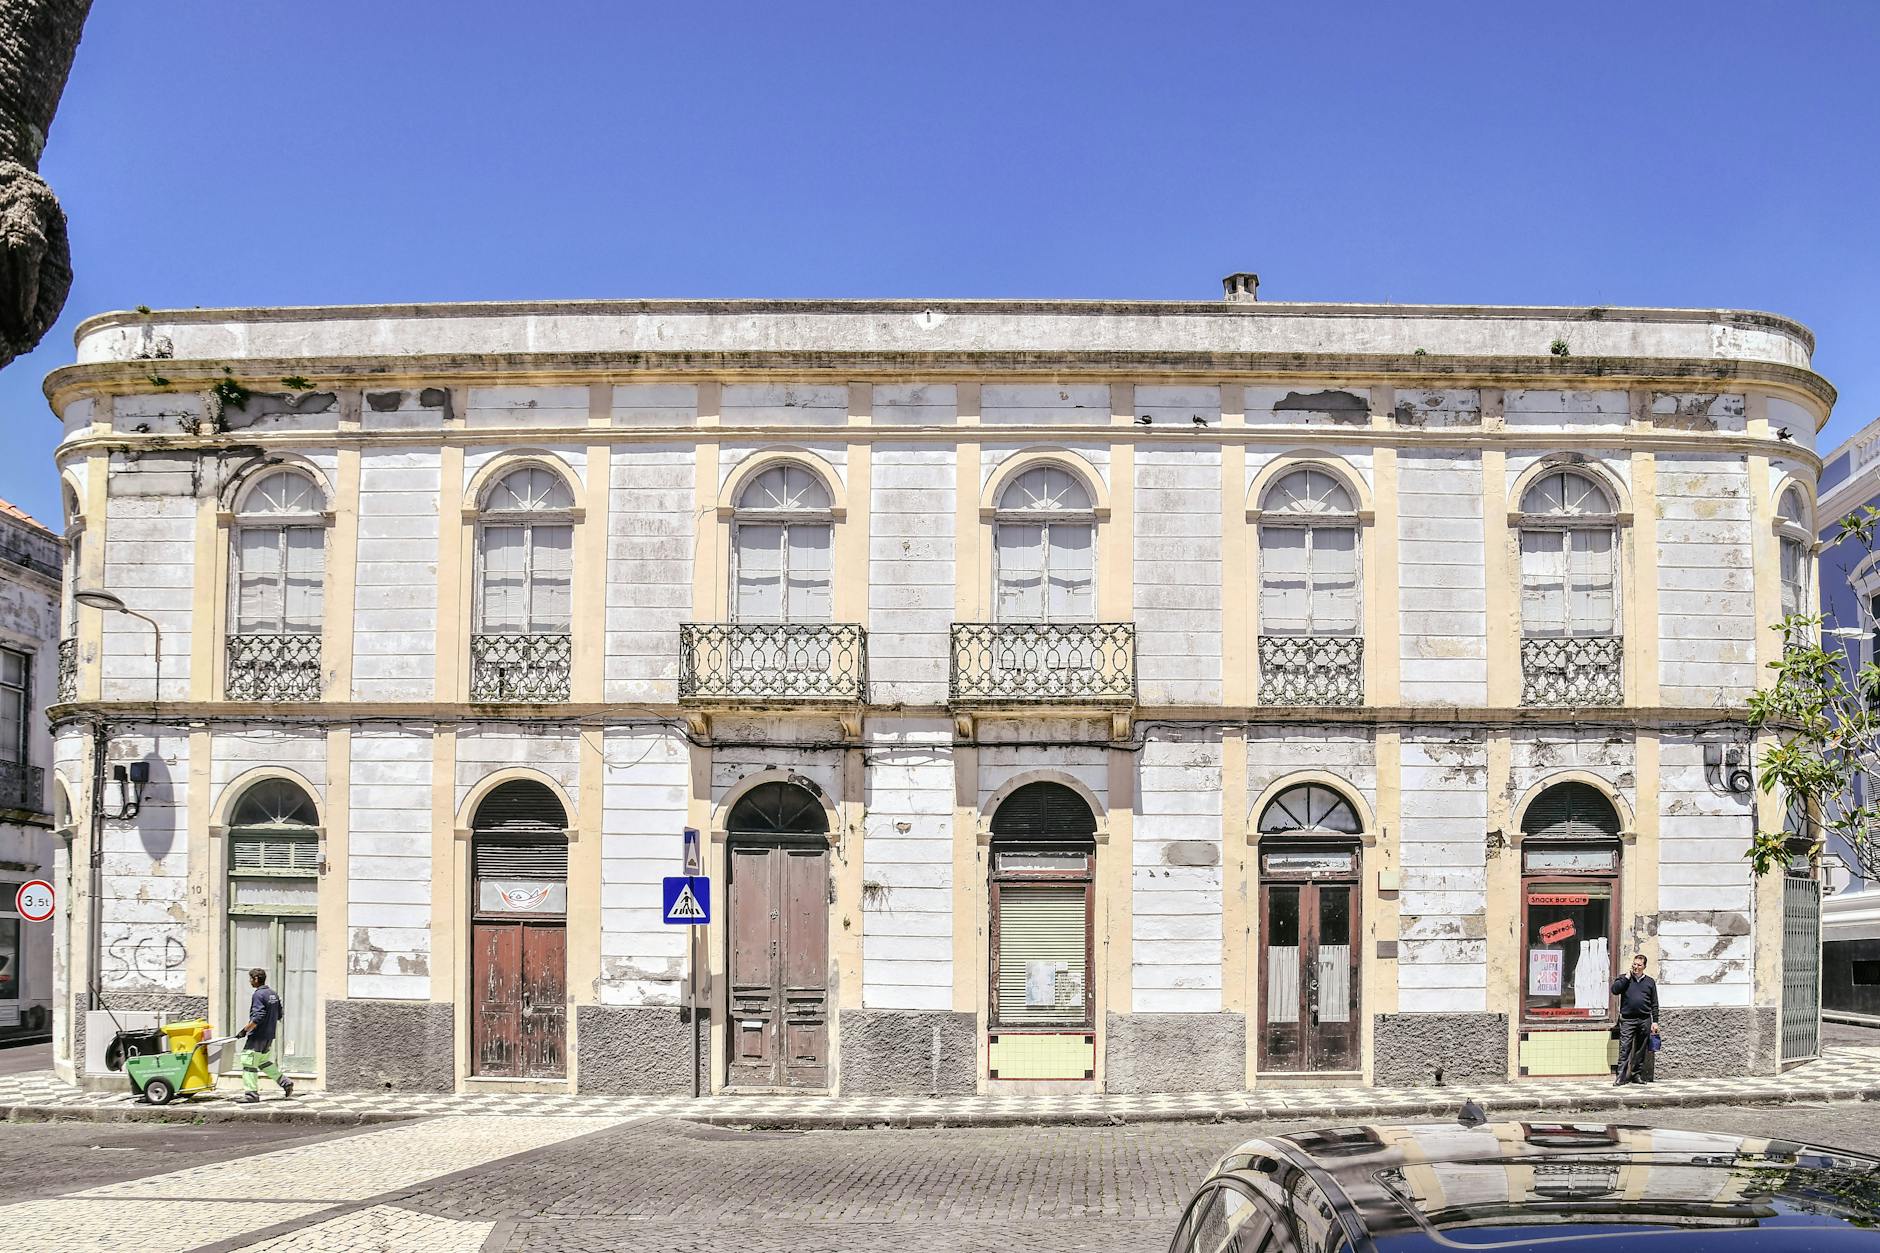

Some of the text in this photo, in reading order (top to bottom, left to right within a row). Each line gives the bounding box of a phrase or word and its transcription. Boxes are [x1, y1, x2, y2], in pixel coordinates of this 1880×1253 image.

[191, 885, 202, 895] 10
[24, 895, 50, 907] 3.5t
[1531, 896, 1554, 904] Snack
[108, 935, 187, 982] SCP
